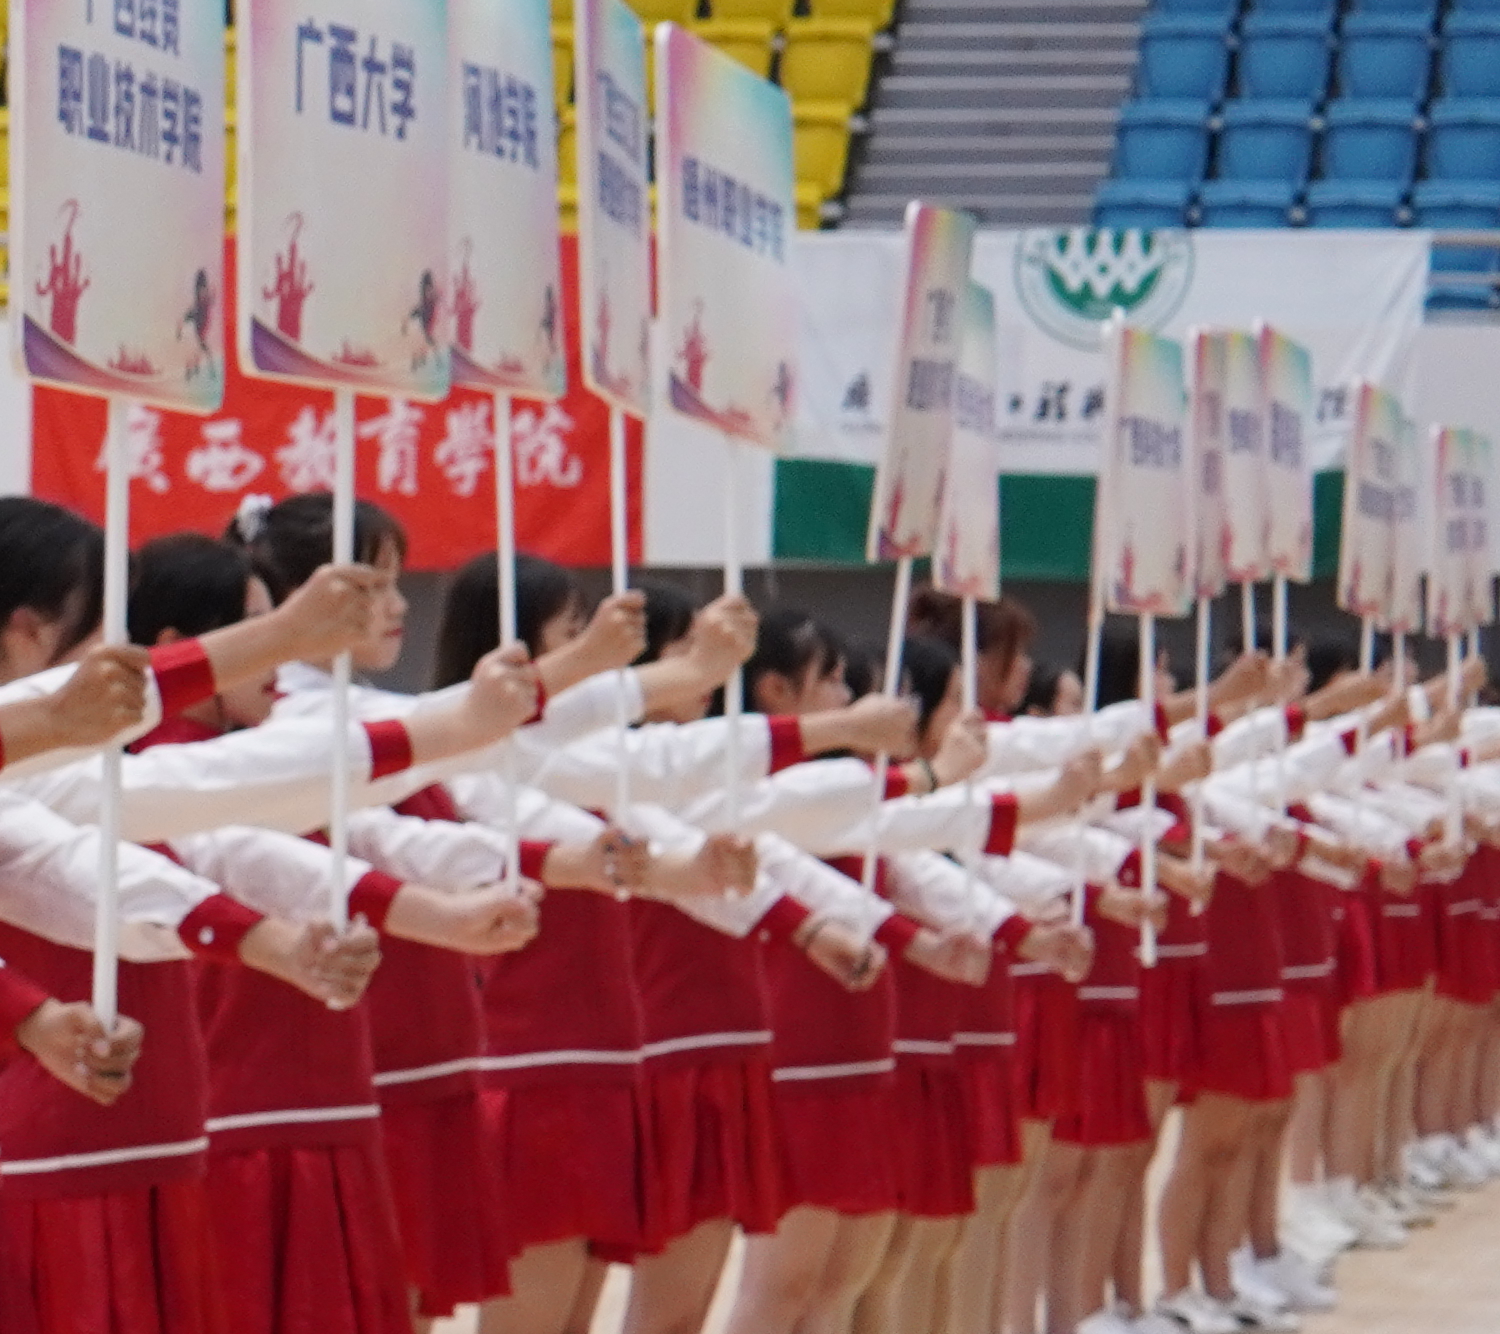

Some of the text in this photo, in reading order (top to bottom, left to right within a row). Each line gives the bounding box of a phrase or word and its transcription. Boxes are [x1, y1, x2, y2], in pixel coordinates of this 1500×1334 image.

[56, 41, 204, 175] 职业技术学院
[295, 17, 417, 142] 广西大学
